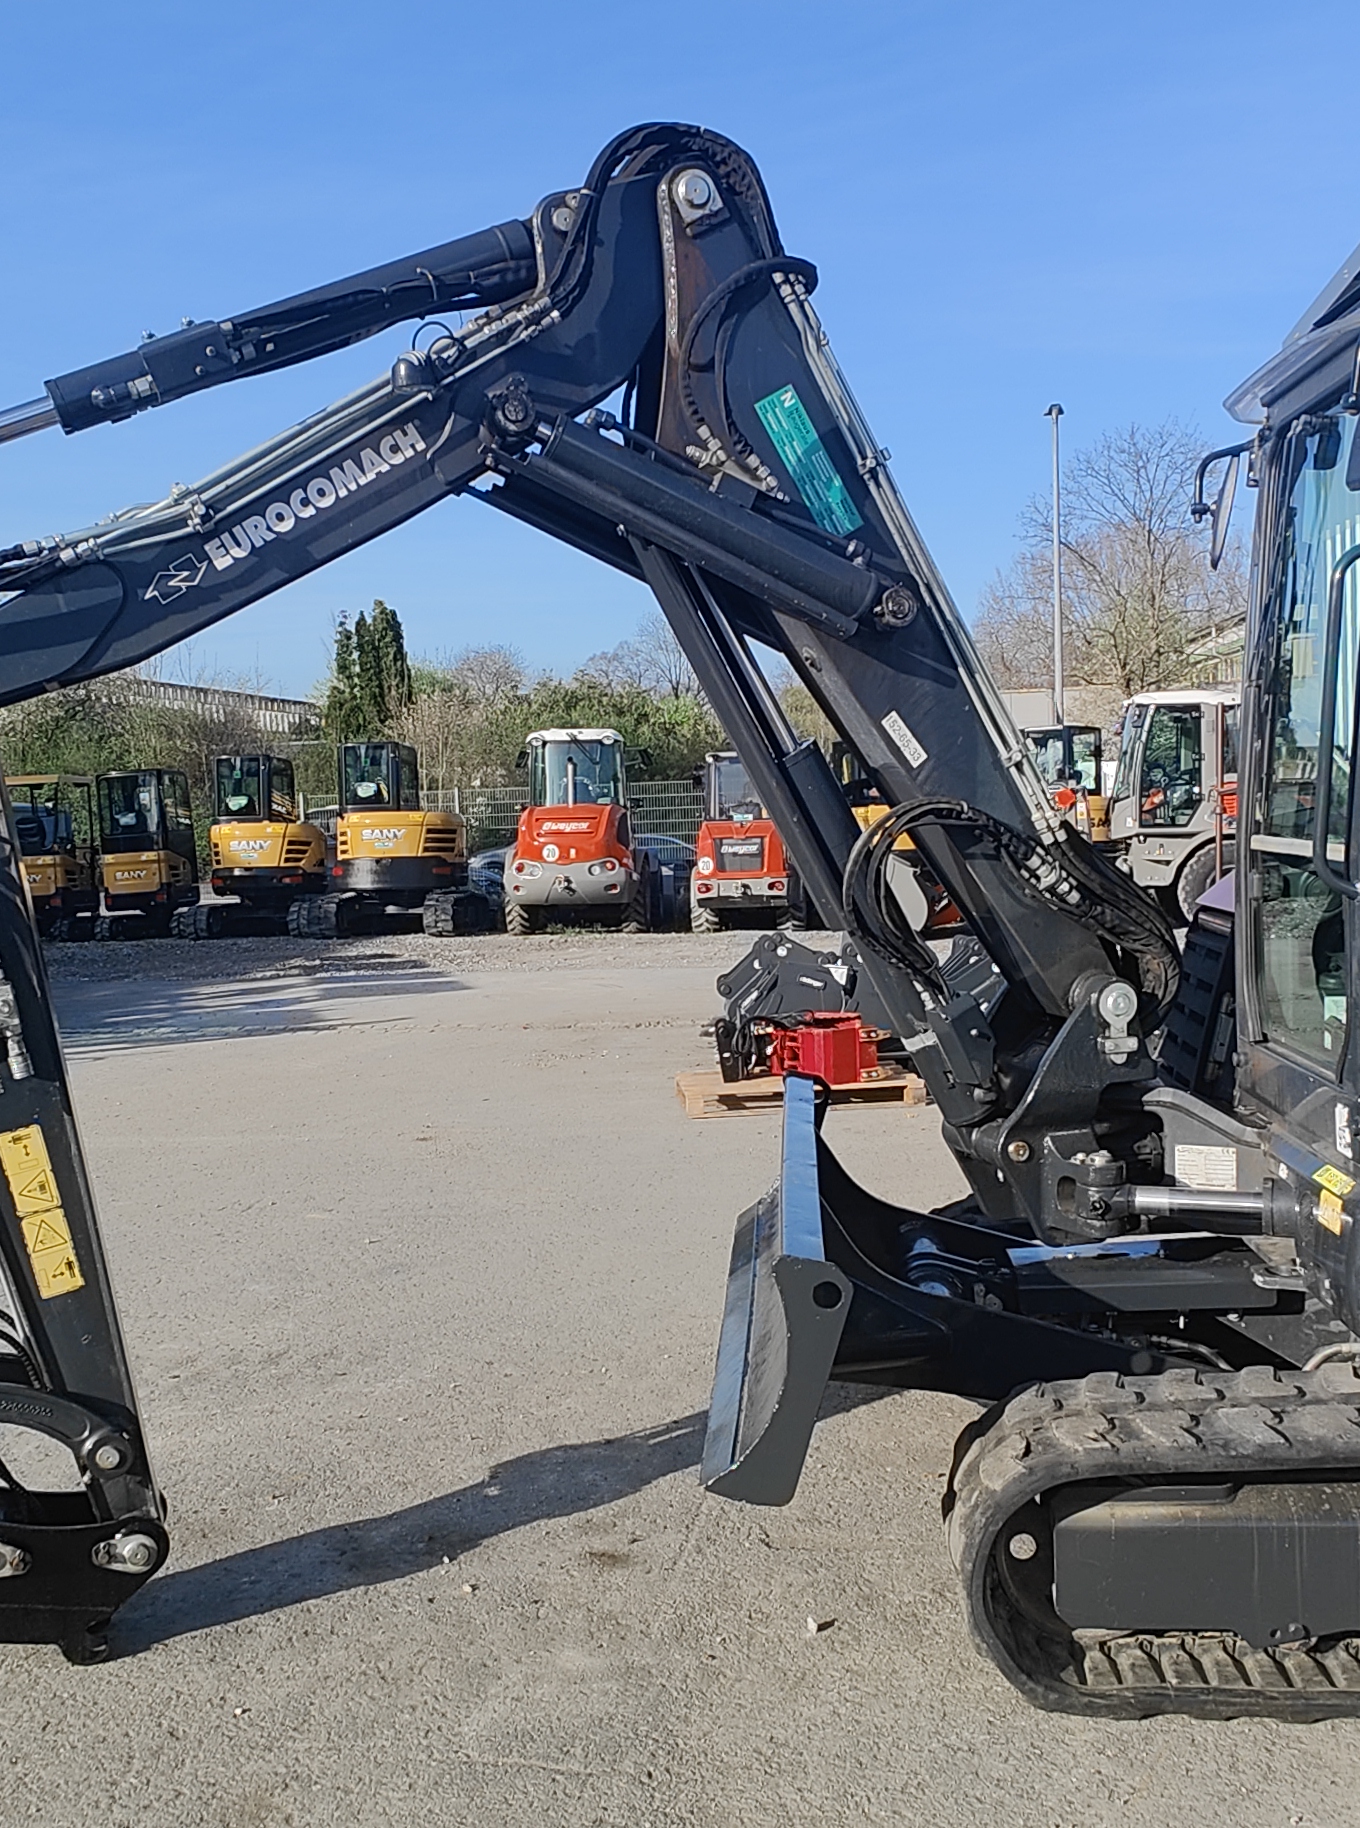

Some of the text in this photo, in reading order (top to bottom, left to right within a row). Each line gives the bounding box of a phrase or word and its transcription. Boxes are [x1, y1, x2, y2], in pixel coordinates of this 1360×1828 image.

[203, 421, 427, 572] EUROCOMACH
[361, 829, 406, 841] SANY
[228, 840, 272, 852] SANY
[545, 847, 556, 859] 20
[701, 860, 711, 871] 20
[115, 870, 147, 880] SANY
